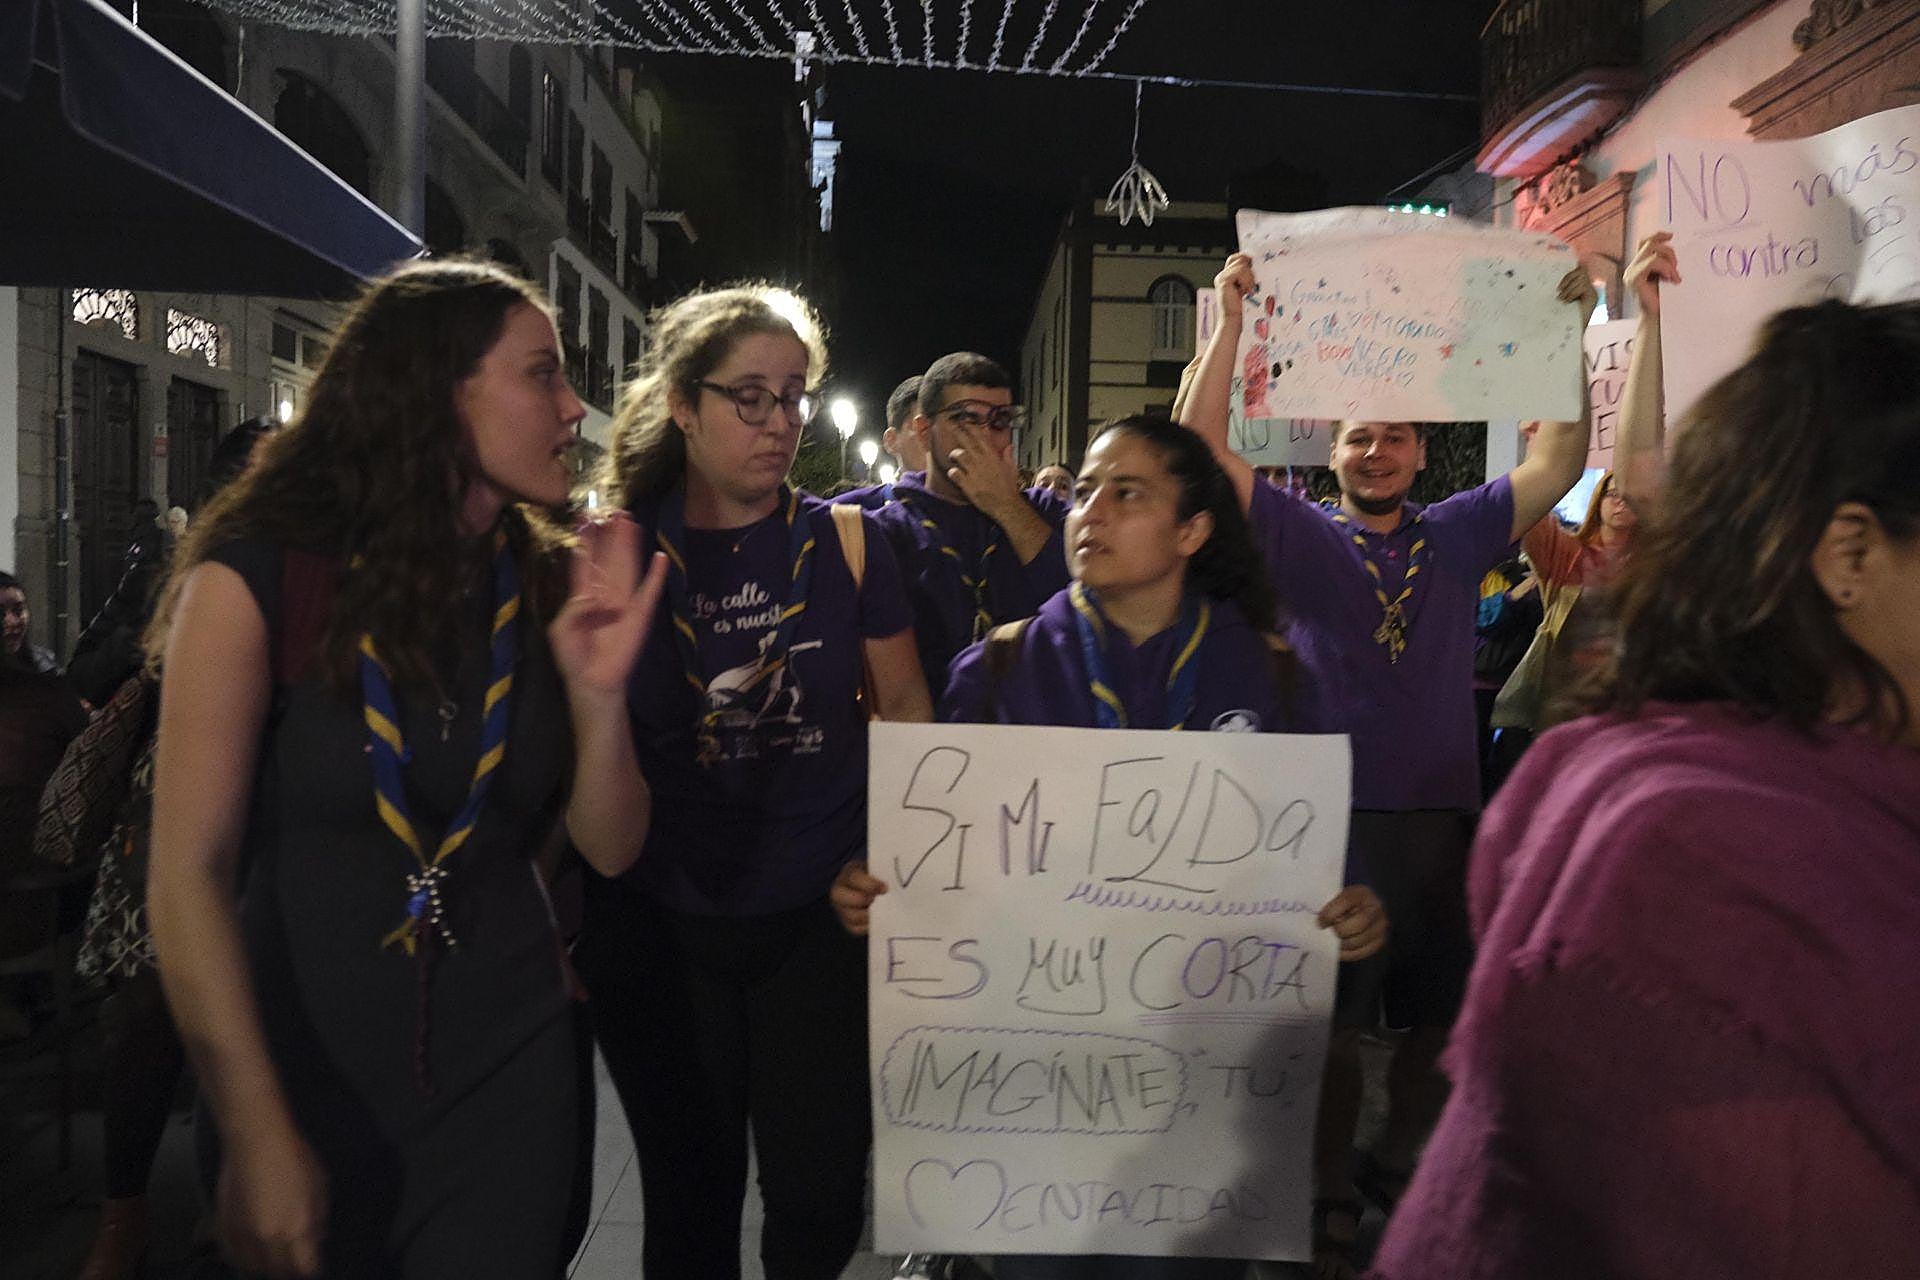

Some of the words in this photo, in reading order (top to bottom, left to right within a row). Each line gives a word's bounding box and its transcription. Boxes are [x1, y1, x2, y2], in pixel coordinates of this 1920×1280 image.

[1667, 152, 1750, 226] NO
[1792, 136, 1920, 206] más
[1709, 232, 1819, 281] contra
[722, 581, 770, 611] calle
[736, 604, 785, 630] nuest
[886, 936, 990, 1000] ES
[1128, 933, 1311, 1012] CORTA
